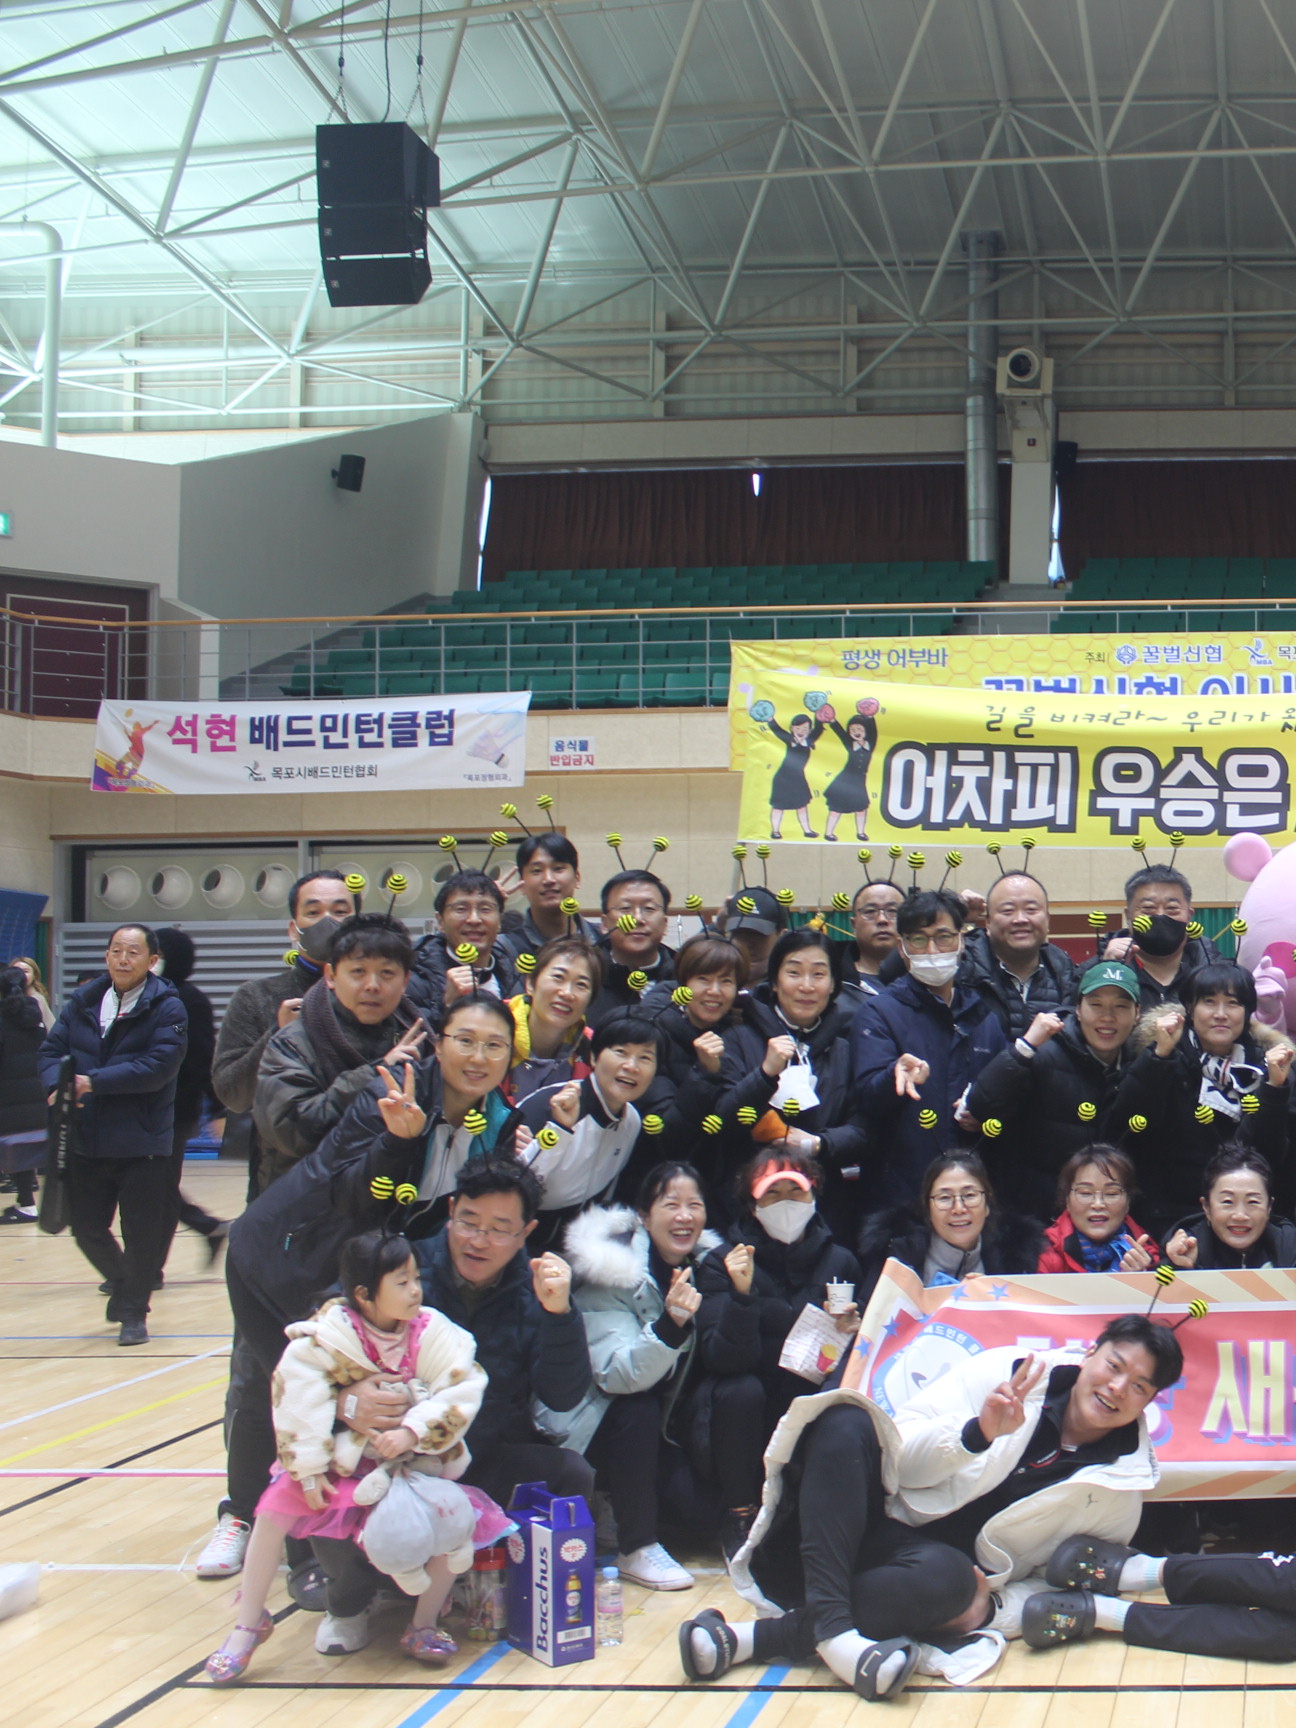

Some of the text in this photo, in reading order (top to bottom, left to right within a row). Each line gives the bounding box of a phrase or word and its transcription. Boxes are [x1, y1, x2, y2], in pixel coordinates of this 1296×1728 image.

[840, 647, 948, 671] 평생 어부바
[1084, 644, 1222, 664] 주최 꿀벌신협
[167, 709, 456, 754] 석현 배드민턴클럽
[986, 705, 1035, 738] 길을
[1181, 710, 1270, 733] 우리가
[554, 740, 589, 752] 음식물
[271, 764, 378, 780] 목포시배드민턴협회
[550, 754, 595, 767] 반입금지
[886, 746, 1073, 827] 어차피
[1095, 751, 1283, 829] 우승은
[535, 1546, 549, 1653] Bacchus
